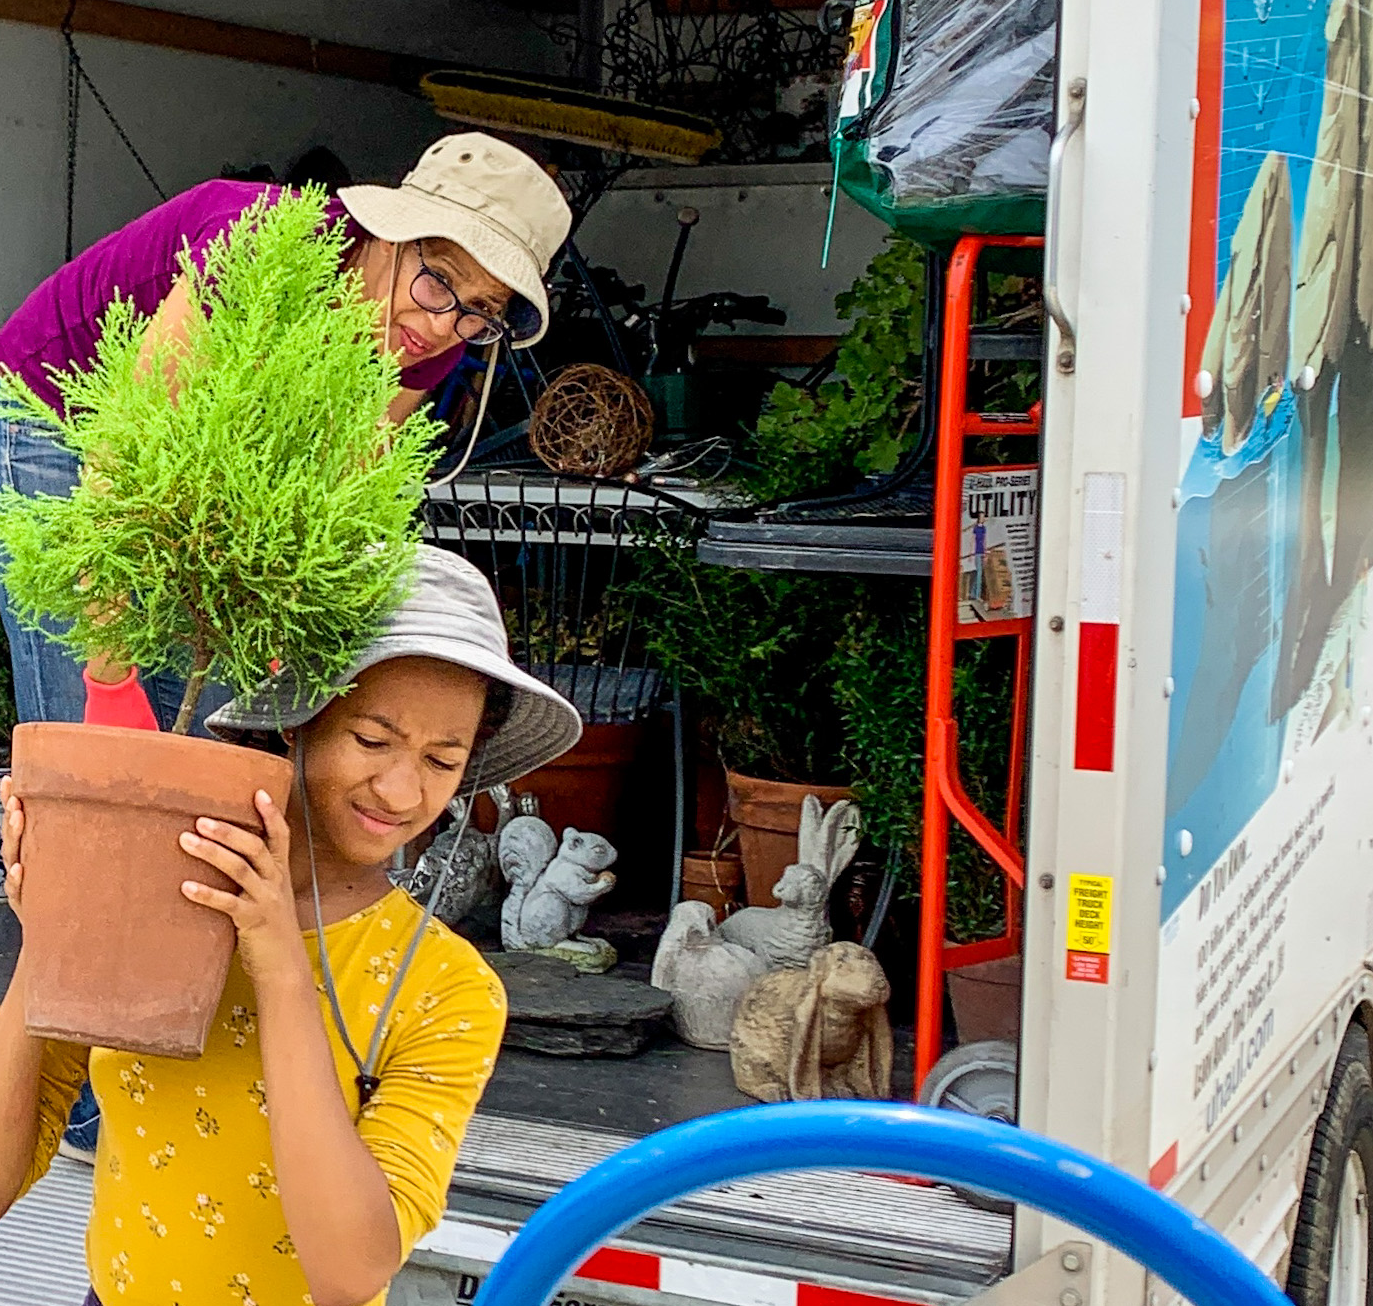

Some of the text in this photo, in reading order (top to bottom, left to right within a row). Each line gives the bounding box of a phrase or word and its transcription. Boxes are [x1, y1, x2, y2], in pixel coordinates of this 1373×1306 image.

[968, 490, 1037, 519] UTILITY
[1074, 887, 1108, 899] FREIGHT
[1077, 898, 1104, 909] TRUCK
[1079, 909, 1100, 919] DECK
[1075, 919, 1105, 930] HEIGHT
[1206, 1007, 1274, 1133] uhaul.com
